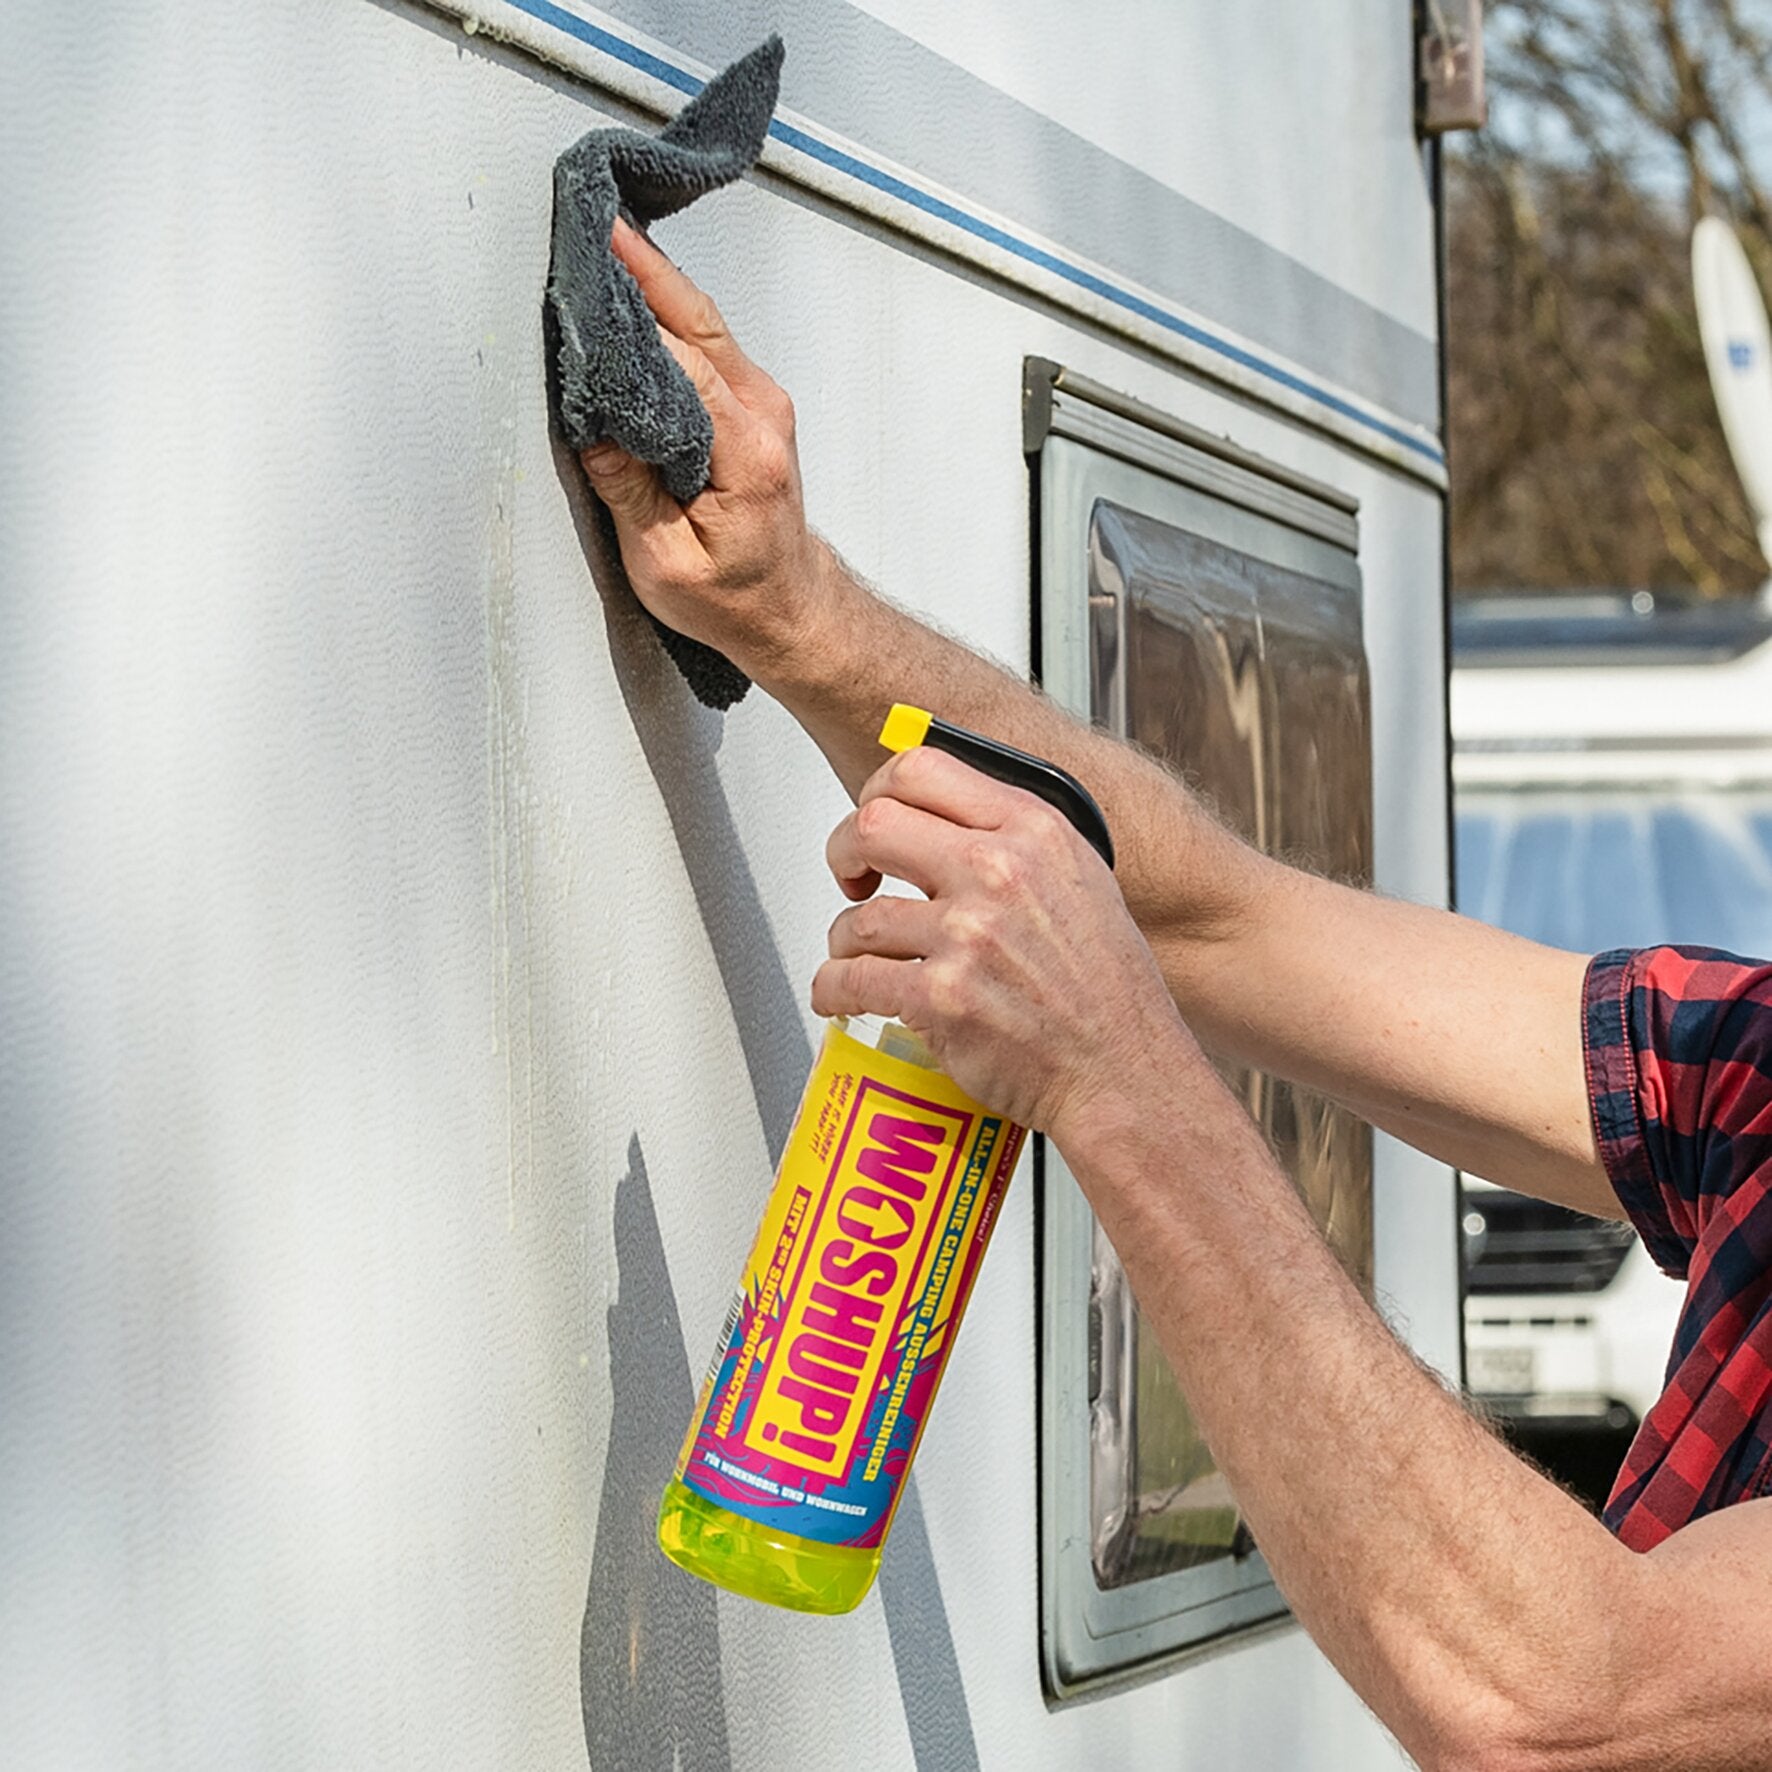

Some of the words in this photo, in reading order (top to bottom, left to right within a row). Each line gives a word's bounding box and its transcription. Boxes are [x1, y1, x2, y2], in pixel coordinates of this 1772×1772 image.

[785, 1192, 807, 1234] MIT
[949, 1125, 994, 1231] ALL-IN-ONE
[919, 1234, 958, 1318] CAMPING
[713, 1265, 782, 1439] SKIN-PROTECTION
[862, 1321, 928, 1482] AUSSENREINIGER
